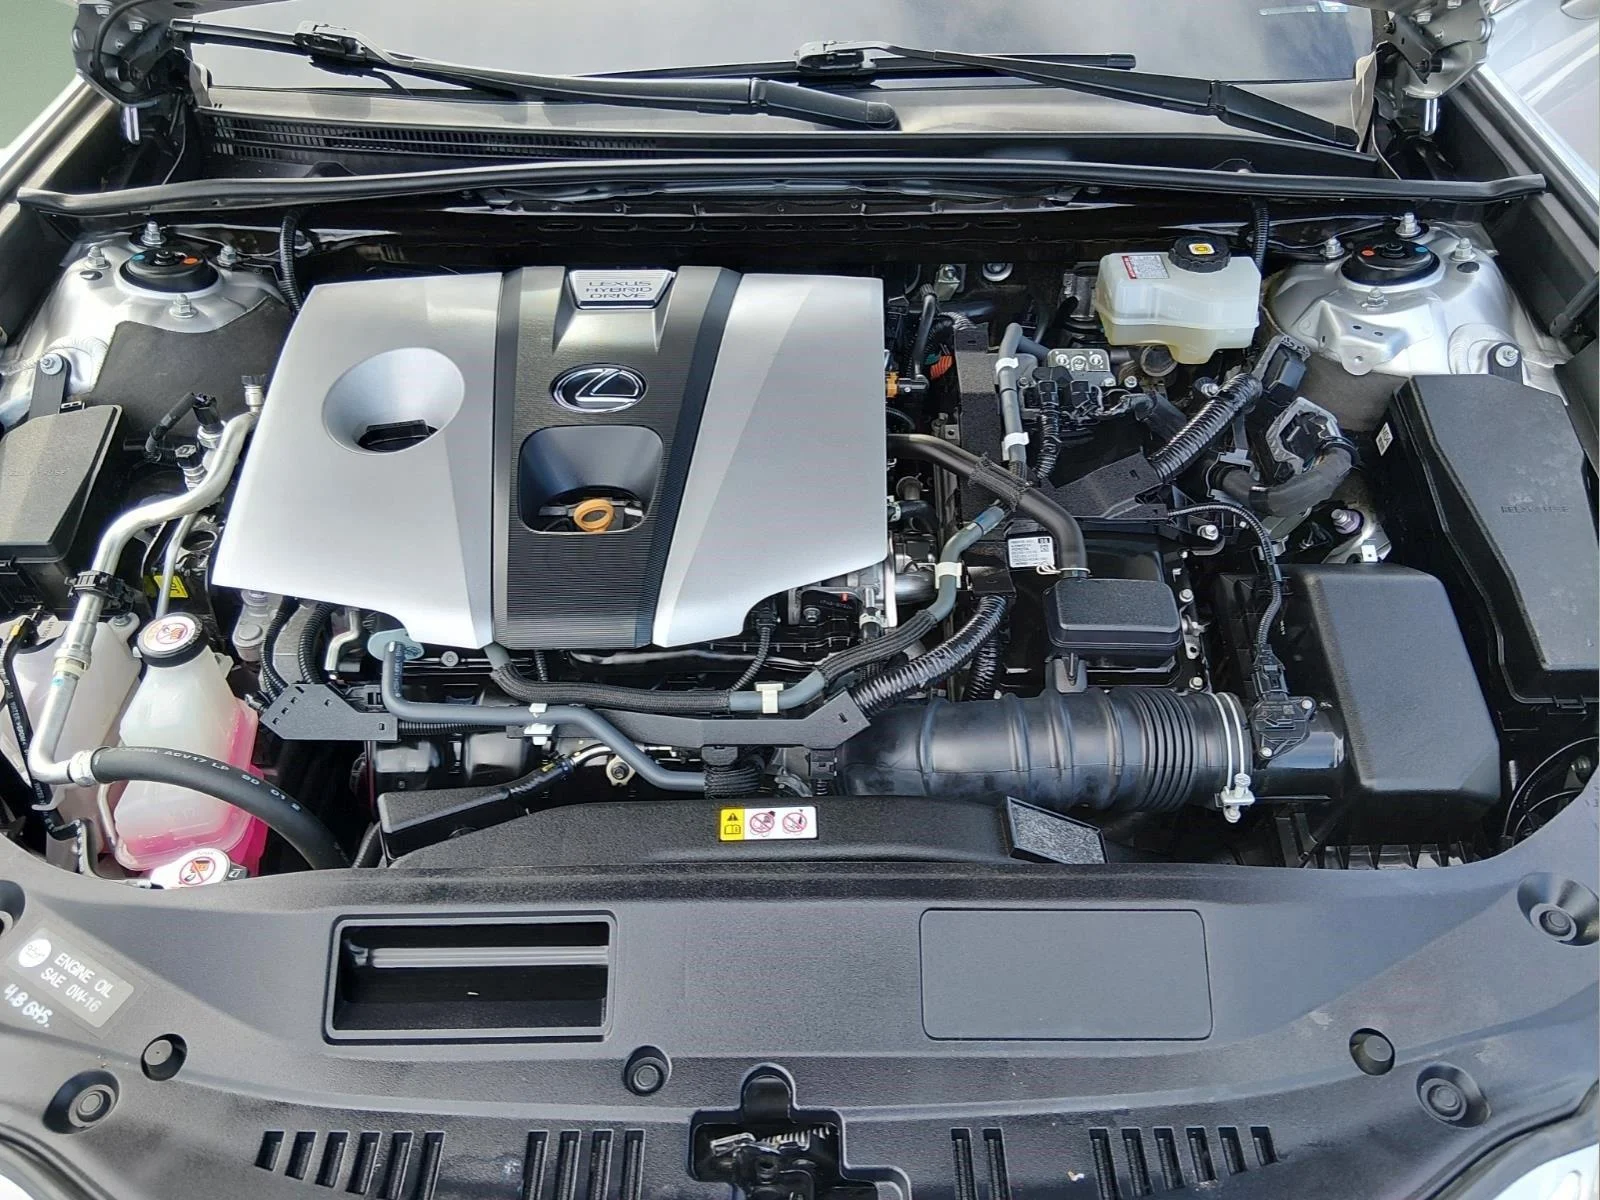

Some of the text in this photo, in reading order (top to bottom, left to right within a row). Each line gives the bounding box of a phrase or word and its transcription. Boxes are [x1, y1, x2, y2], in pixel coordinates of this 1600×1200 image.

[4, 984, 28, 1007] 4.8
[40, 967, 102, 1013] SAE 0W-16
[54, 952, 115, 998] ENGINE OIL
